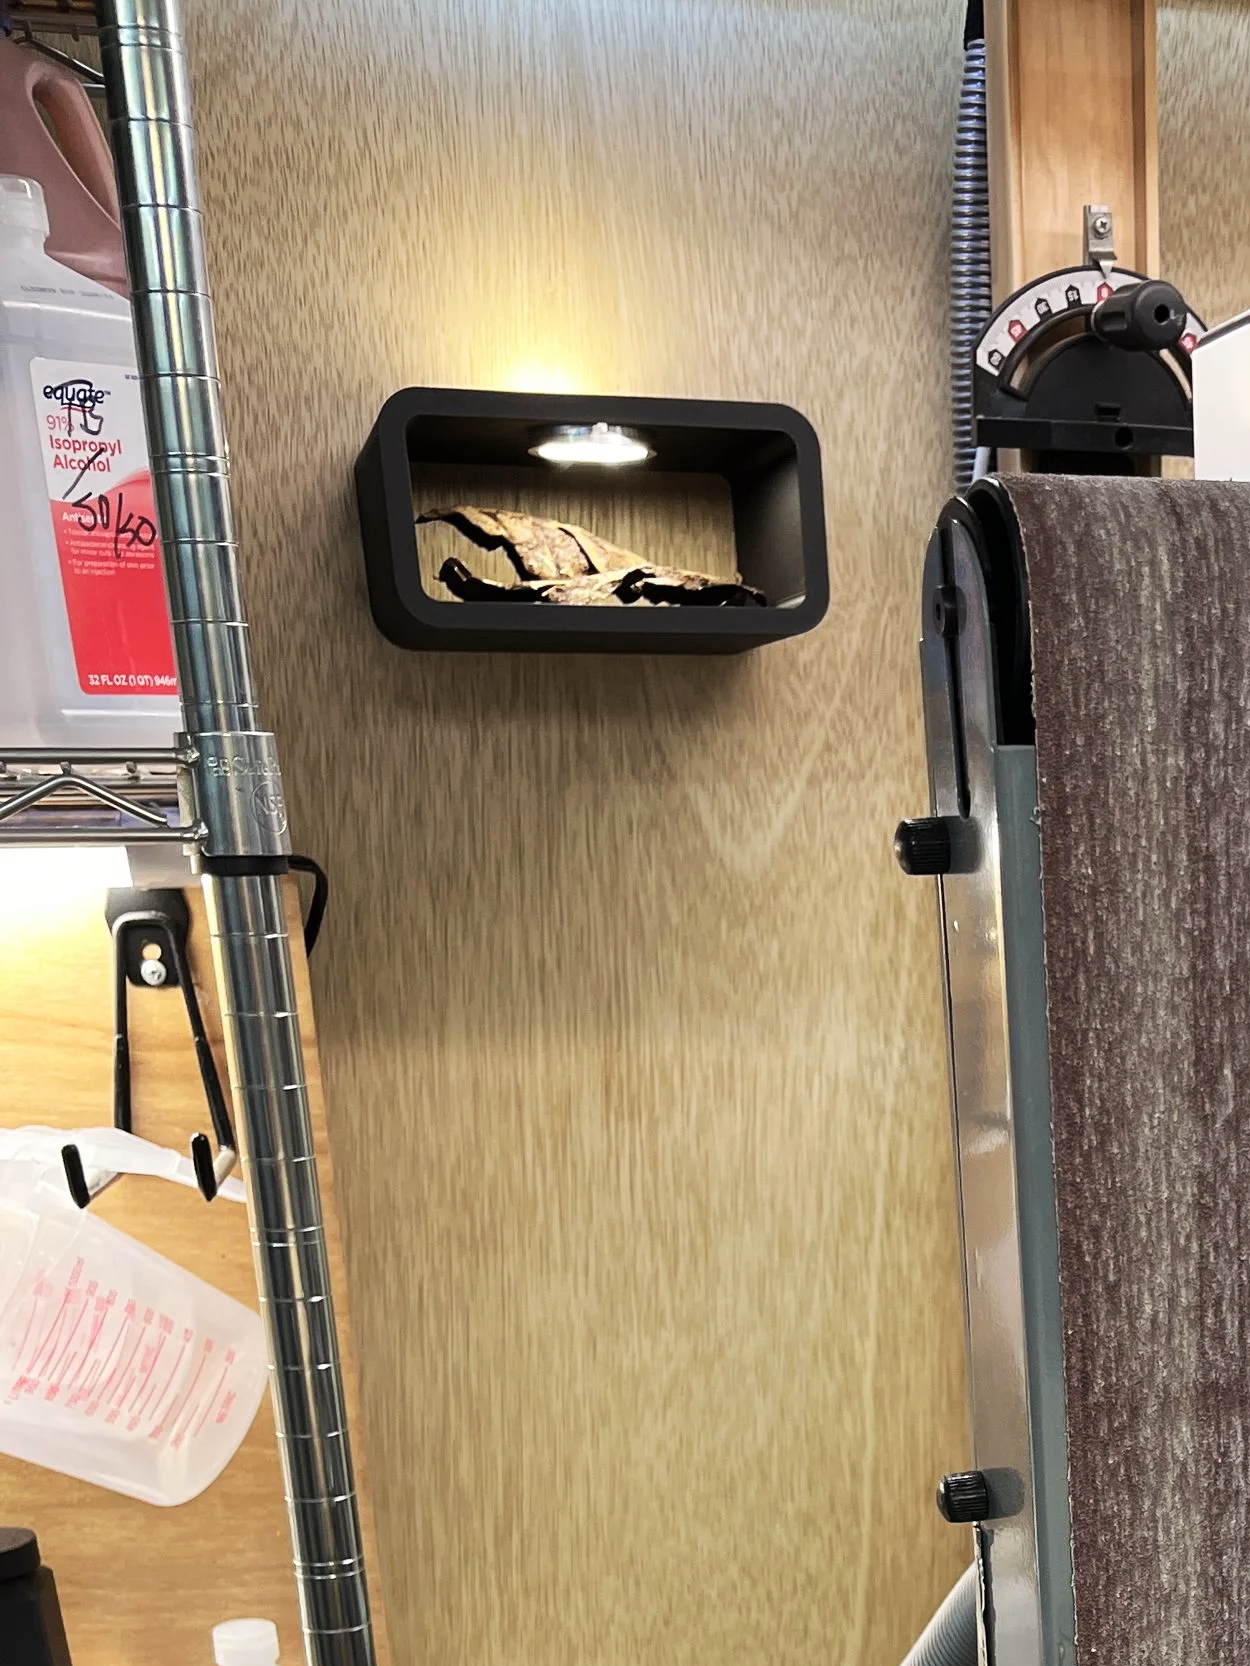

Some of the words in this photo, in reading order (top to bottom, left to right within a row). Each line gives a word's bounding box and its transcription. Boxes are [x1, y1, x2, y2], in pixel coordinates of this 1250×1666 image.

[43, 385, 105, 406] equate
[46, 414, 75, 433] 91%
[49, 434, 122, 457] Isopropyl
[53, 454, 111, 472] Alcohol
[88, 674, 100, 686] 32
[101, 674, 113, 686] FL
[113, 674, 127, 686] OZ
